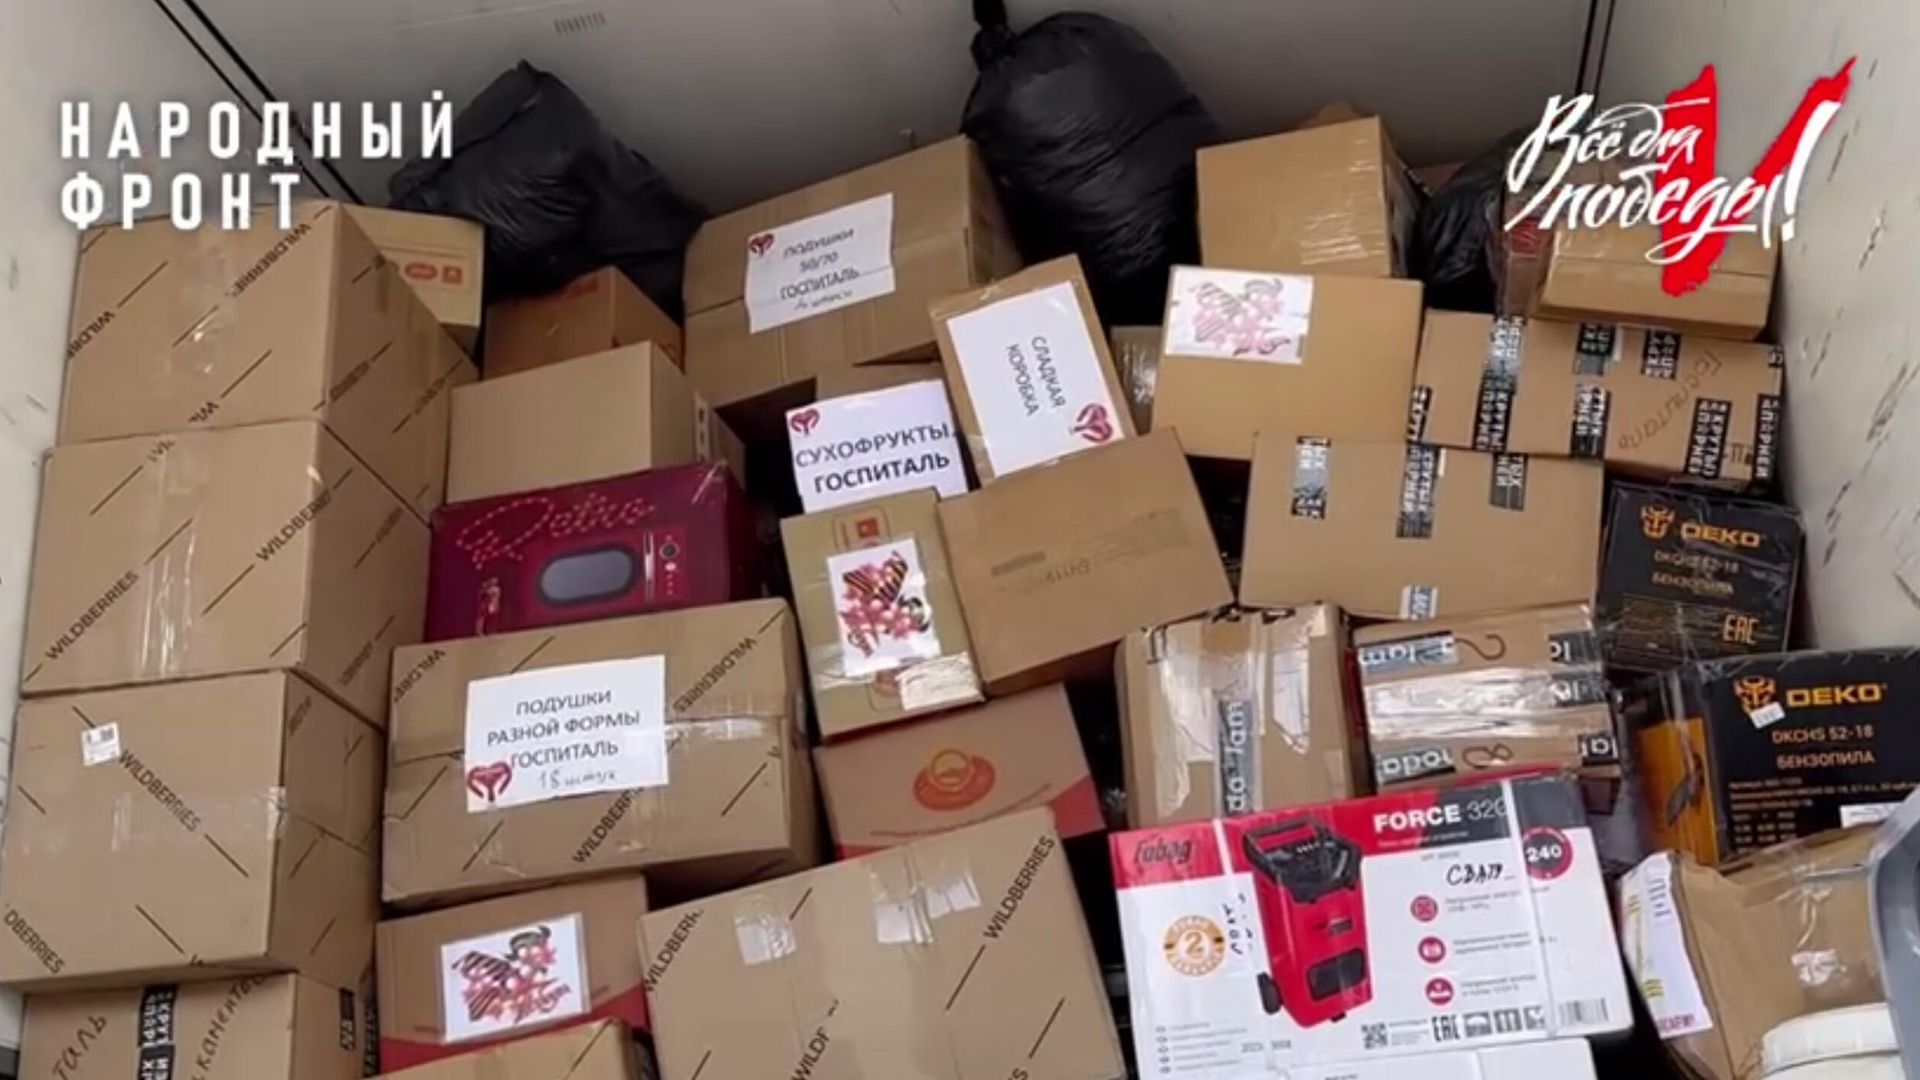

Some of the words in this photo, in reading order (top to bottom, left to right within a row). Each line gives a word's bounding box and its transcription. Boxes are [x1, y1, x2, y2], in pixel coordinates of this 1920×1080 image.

[783, 228, 855, 260] ПОДУШКИ
[780, 266, 860, 300] ГОСПИТАЛЬ
[1006, 344, 1039, 417] КОРОБКА
[1031, 335, 1066, 408] СЛАДКАЯ
[814, 453, 950, 493] ГОСПИТАЛЬ
[1680, 522, 1762, 548] DEKO
[45, 570, 140, 661] WILDBERRIES
[516, 690, 612, 716] ПОДУШКИ
[1786, 684, 1881, 707] DEKO
[487, 719, 560, 746] РАЗНОЙ
[564, 711, 641, 734] ФОРМЫ
[1828, 724, 1874, 741] 52-18
[511, 741, 619, 769] ГОСПИТАЛЬ
[1776, 750, 1876, 770] БЕНЗОПИЛА
[120, 749, 201, 833] WILDBERRIES
[1373, 804, 1461, 833] FORCE
[1526, 844, 1562, 863] 240
[984, 835, 1056, 940] WILDBERRIES
[1186, 931, 1204, 954] 2
